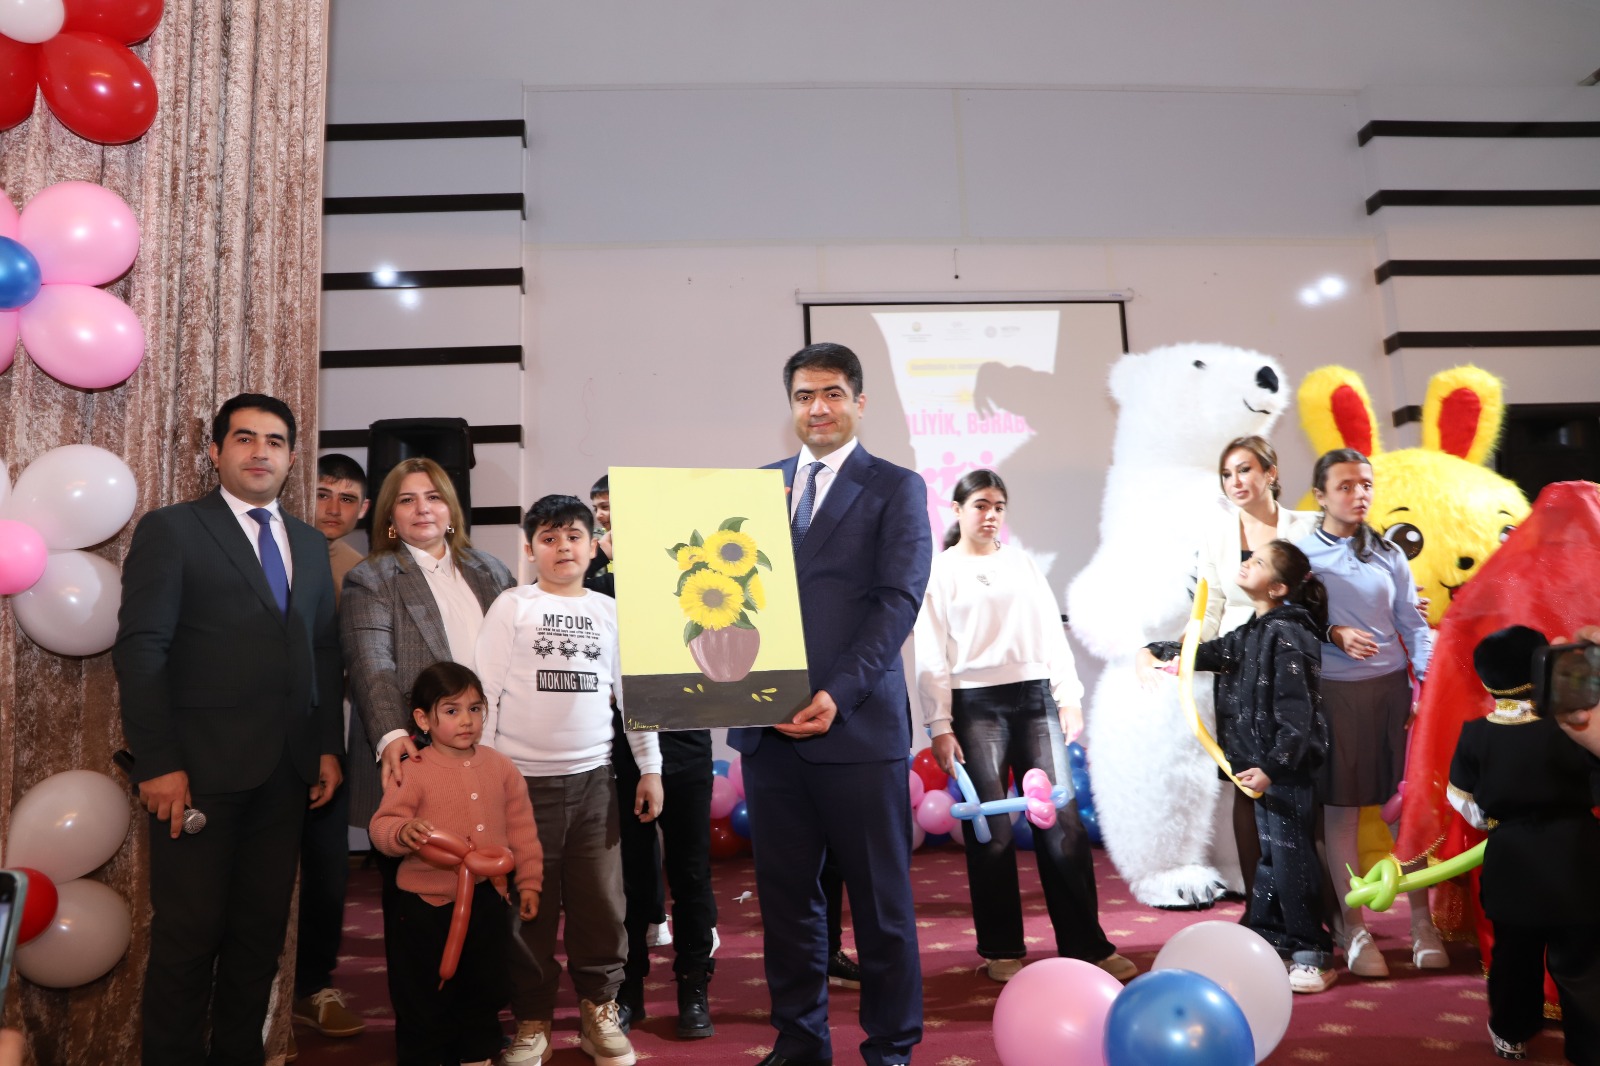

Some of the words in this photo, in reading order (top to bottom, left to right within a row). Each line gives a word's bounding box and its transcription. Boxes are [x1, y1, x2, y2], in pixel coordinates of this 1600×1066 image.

[905, 409, 961, 437] LİYİK,
[543, 613, 594, 631] MFOUR
[539, 671, 577, 690] MOKING
